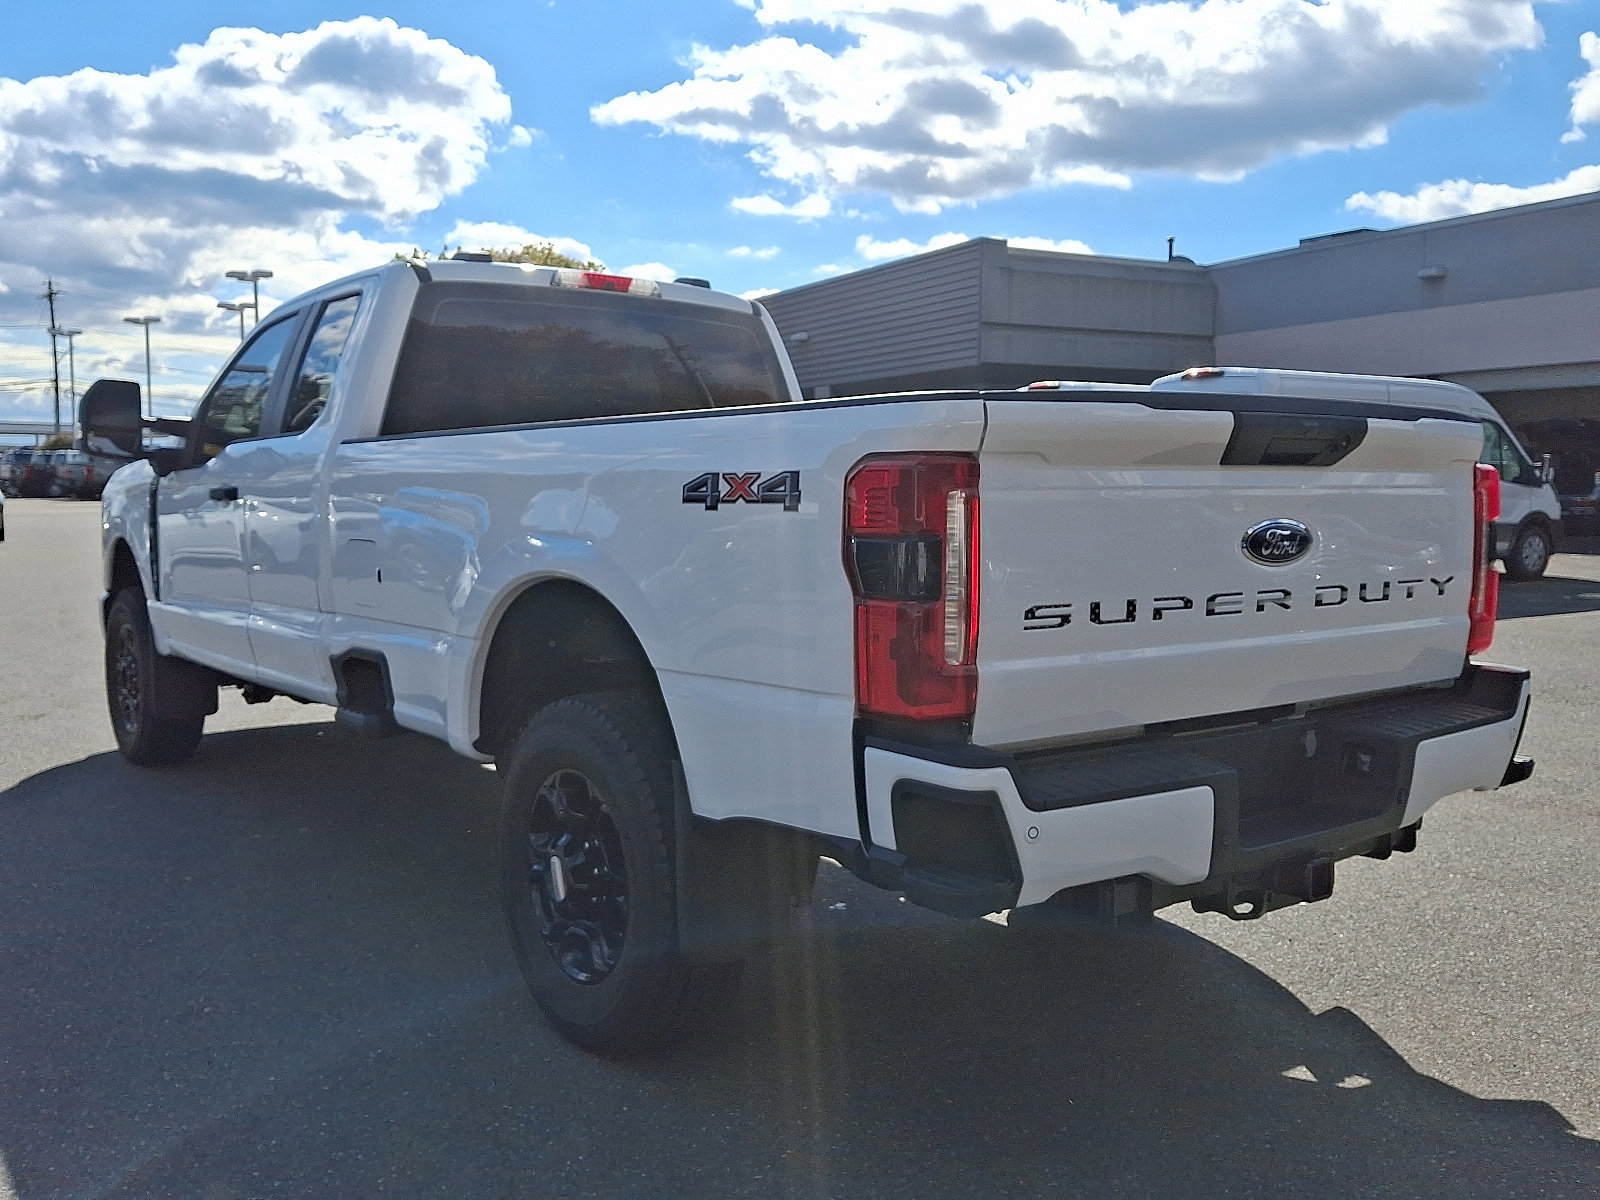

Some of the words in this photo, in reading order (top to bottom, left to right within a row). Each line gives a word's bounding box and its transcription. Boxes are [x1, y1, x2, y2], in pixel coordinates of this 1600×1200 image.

[1261, 528, 1301, 556] Ford
[1023, 588, 1292, 631] SUPER
[1314, 575, 1455, 608] DUTY
